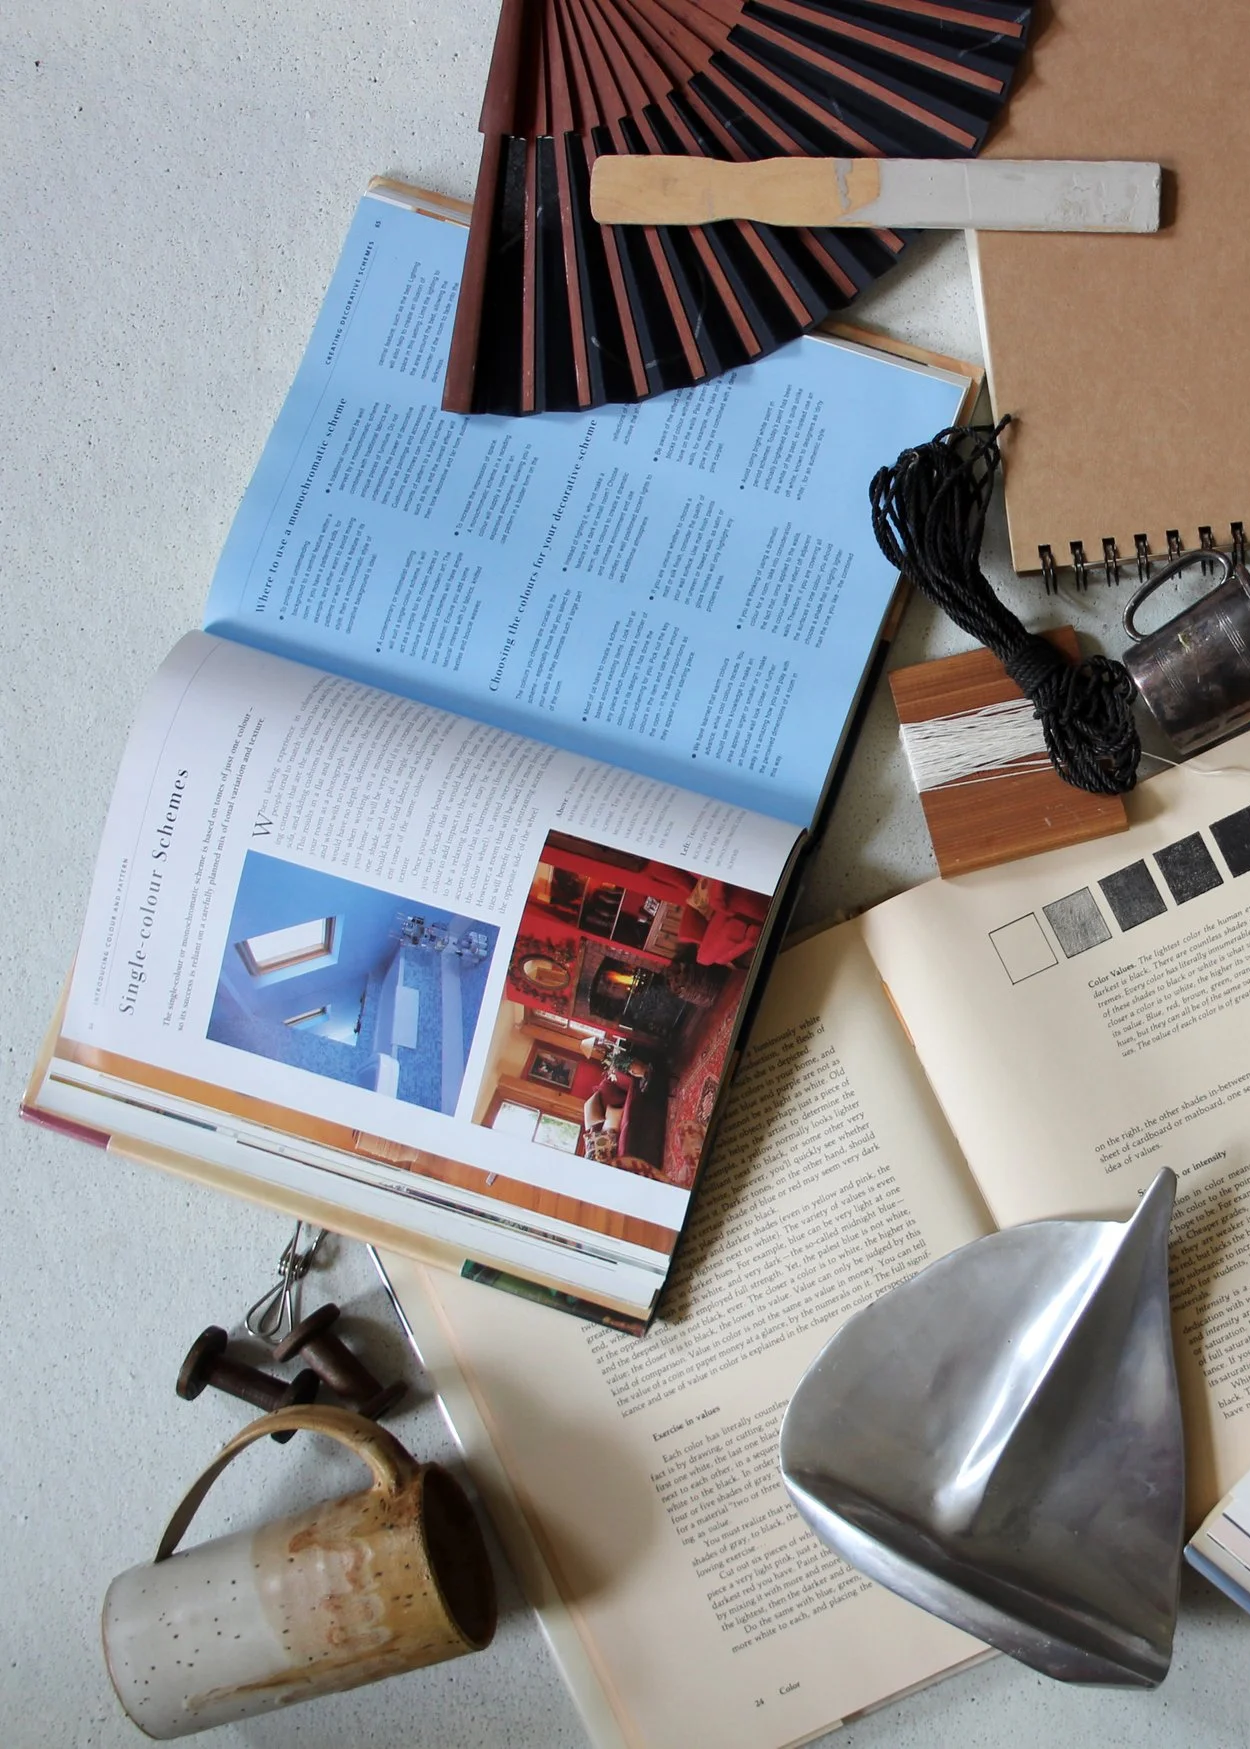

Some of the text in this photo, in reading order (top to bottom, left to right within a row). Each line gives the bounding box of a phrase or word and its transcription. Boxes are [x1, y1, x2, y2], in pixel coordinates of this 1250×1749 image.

[324, 241, 375, 366] CREATING DECORATIVE SCHEMES
[255, 397, 348, 613] Where to use a monochromatic scheme
[488, 419, 597, 692] Choosing the colours for your decorative scheme
[242, 746, 253, 764] and
[230, 763, 247, 800] variation
[223, 800, 235, 823] tonal
[216, 835, 227, 852] mix
[220, 822, 229, 834] of
[162, 712, 252, 1027] The single-colour or monochromatic scheme is based on tones of just one colour
[207, 851, 222, 886] planned
[119, 769, 189, 1015] Single-colour Schemes
[201, 887, 215, 922] carefully
[93, 857, 129, 1006] INTRODUCING COLOUR AND PATTERN
[197, 929, 205, 941] on
[190, 942, 202, 969] reliant
[1087, 974, 1110, 989] Color
[1108, 963, 1137, 978] Values.
[1137, 954, 1153, 965] The
[1153, 939, 1181, 958] lightest
[1182, 930, 1201, 944] color
[1203, 923, 1216, 934] the
[1216, 910, 1244, 927] human
[189, 969, 196, 978] is
[182, 979, 194, 1009] success
[177, 1021, 185, 1032] so
[178, 1010, 188, 1021] its
[1094, 1143, 1107, 1153] on
[1106, 1136, 1121, 1147] the
[1120, 1125, 1144, 1141] right,
[1143, 1117, 1158, 1129] the
[1158, 1106, 1180, 1122] other
[1180, 1094, 1209, 1111] shades
[1099, 1148, 1121, 1164] sheet
[1121, 1141, 1131, 1153] of
[1131, 1121, 1174, 1148] cardboard
[1173, 1118, 1183, 1128] or
[1183, 1096, 1226, 1123] matboard,
[1226, 1090, 1242, 1102] one
[1104, 1143, 1163, 1175] idea of values.
[1181, 1150, 1227, 1176] or intensity
[1192, 1188, 1202, 1197] in
[1203, 1176, 1225, 1192] color
[1195, 1294, 1231, 1315] Intensity
[1232, 1289, 1241, 1297] is
[651, 1405, 721, 1443] Exercise in values
[661, 1398, 790, 1464] Each color has literally countless
[754, 1697, 765, 1708] 24
[778, 1681, 801, 1696] Color
